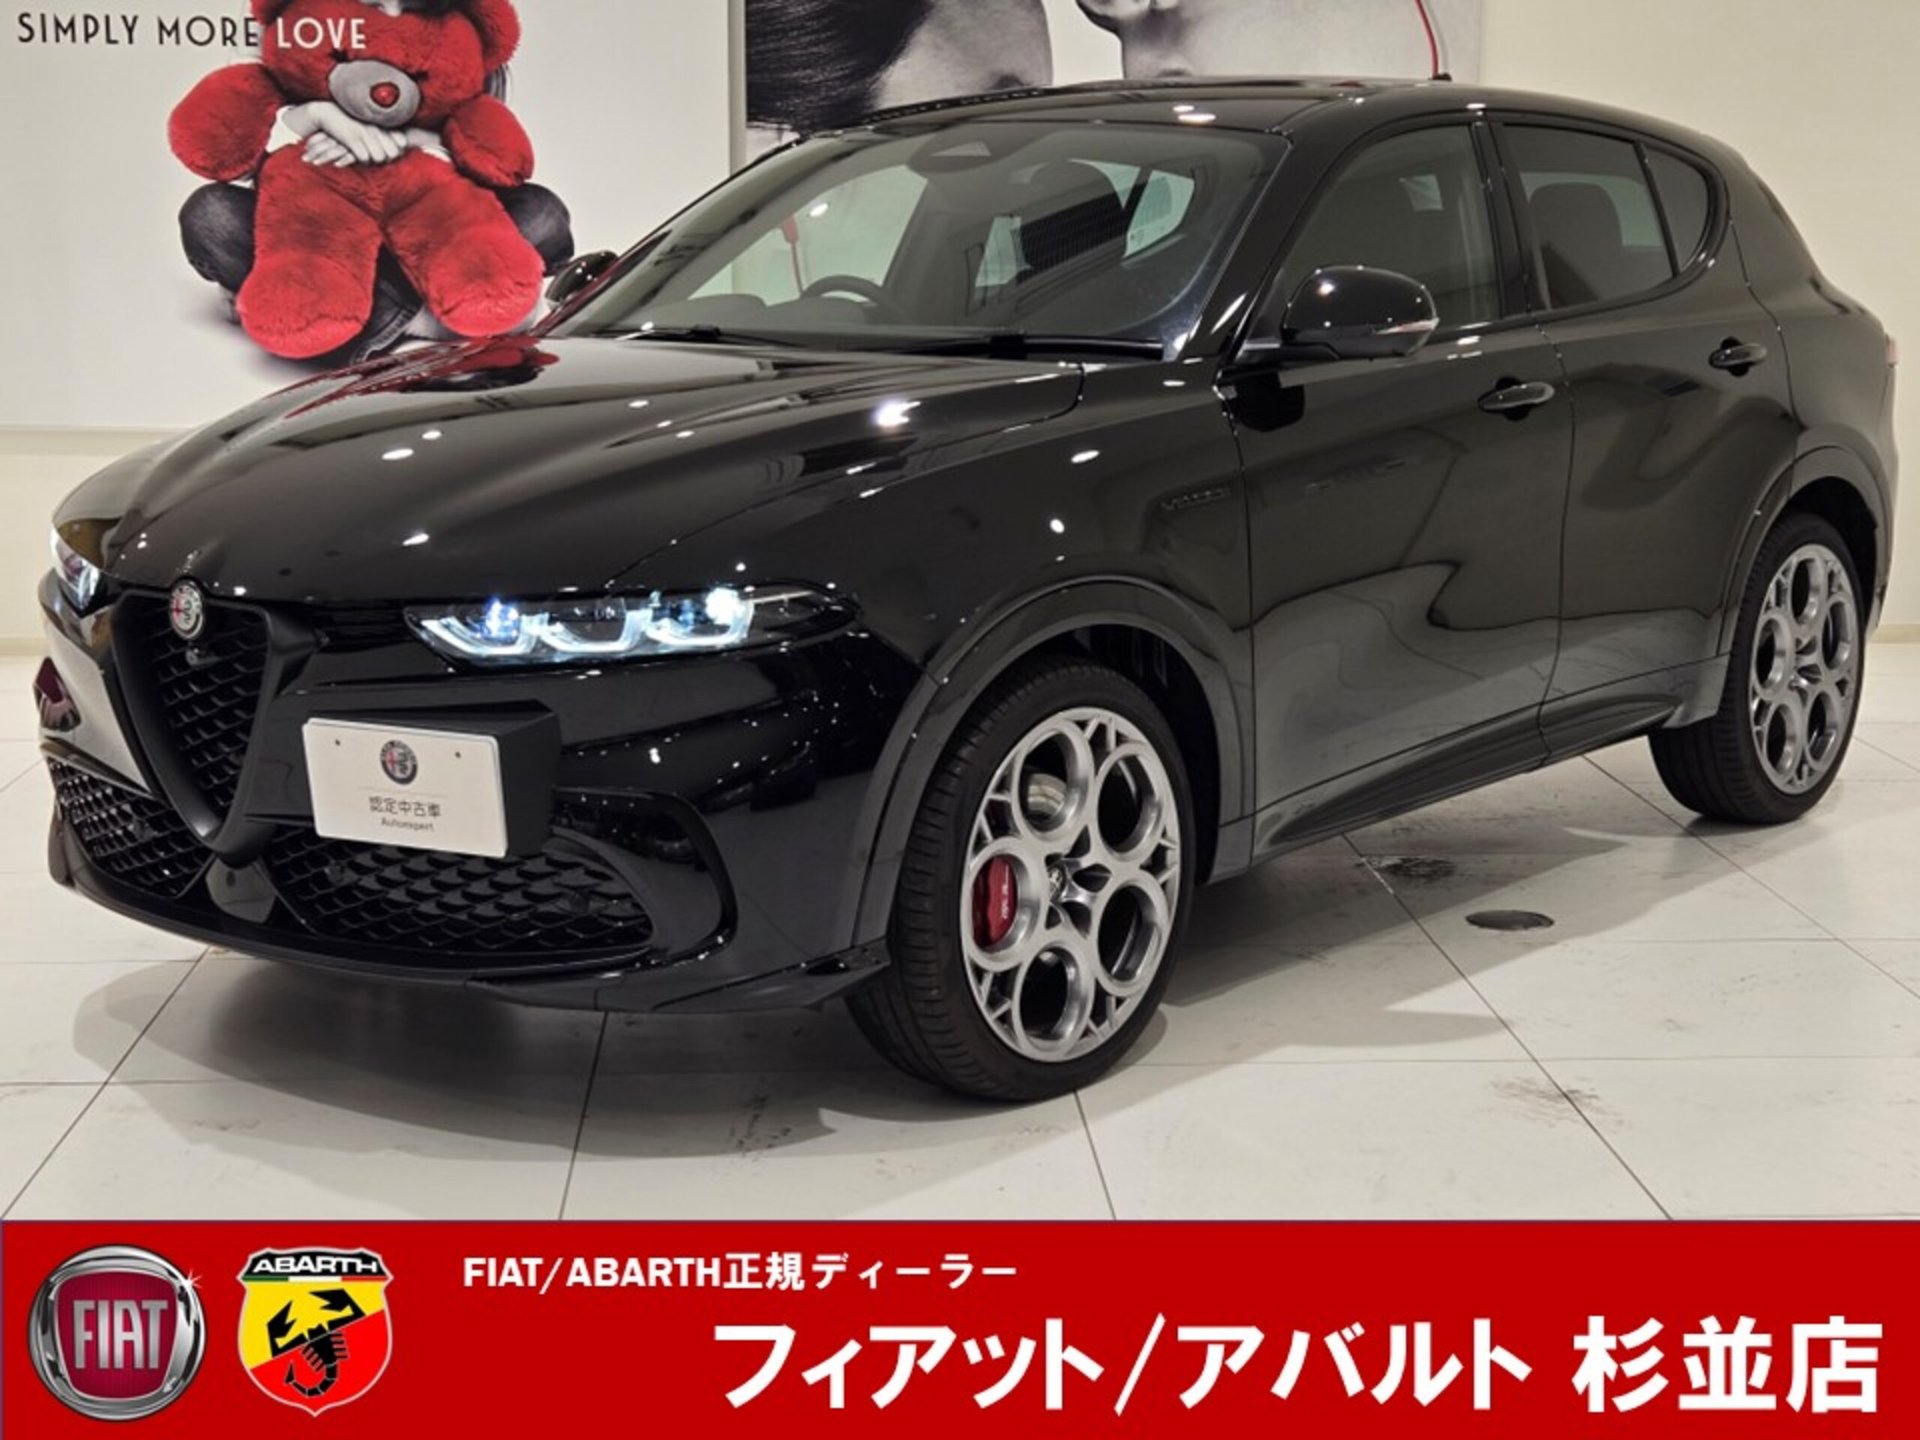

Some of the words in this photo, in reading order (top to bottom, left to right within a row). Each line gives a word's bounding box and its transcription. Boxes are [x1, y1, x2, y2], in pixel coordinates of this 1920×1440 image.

[18, 12, 139, 46] SIMPLY
[157, 16, 259, 48] MORE
[276, 17, 367, 49] LOVE
